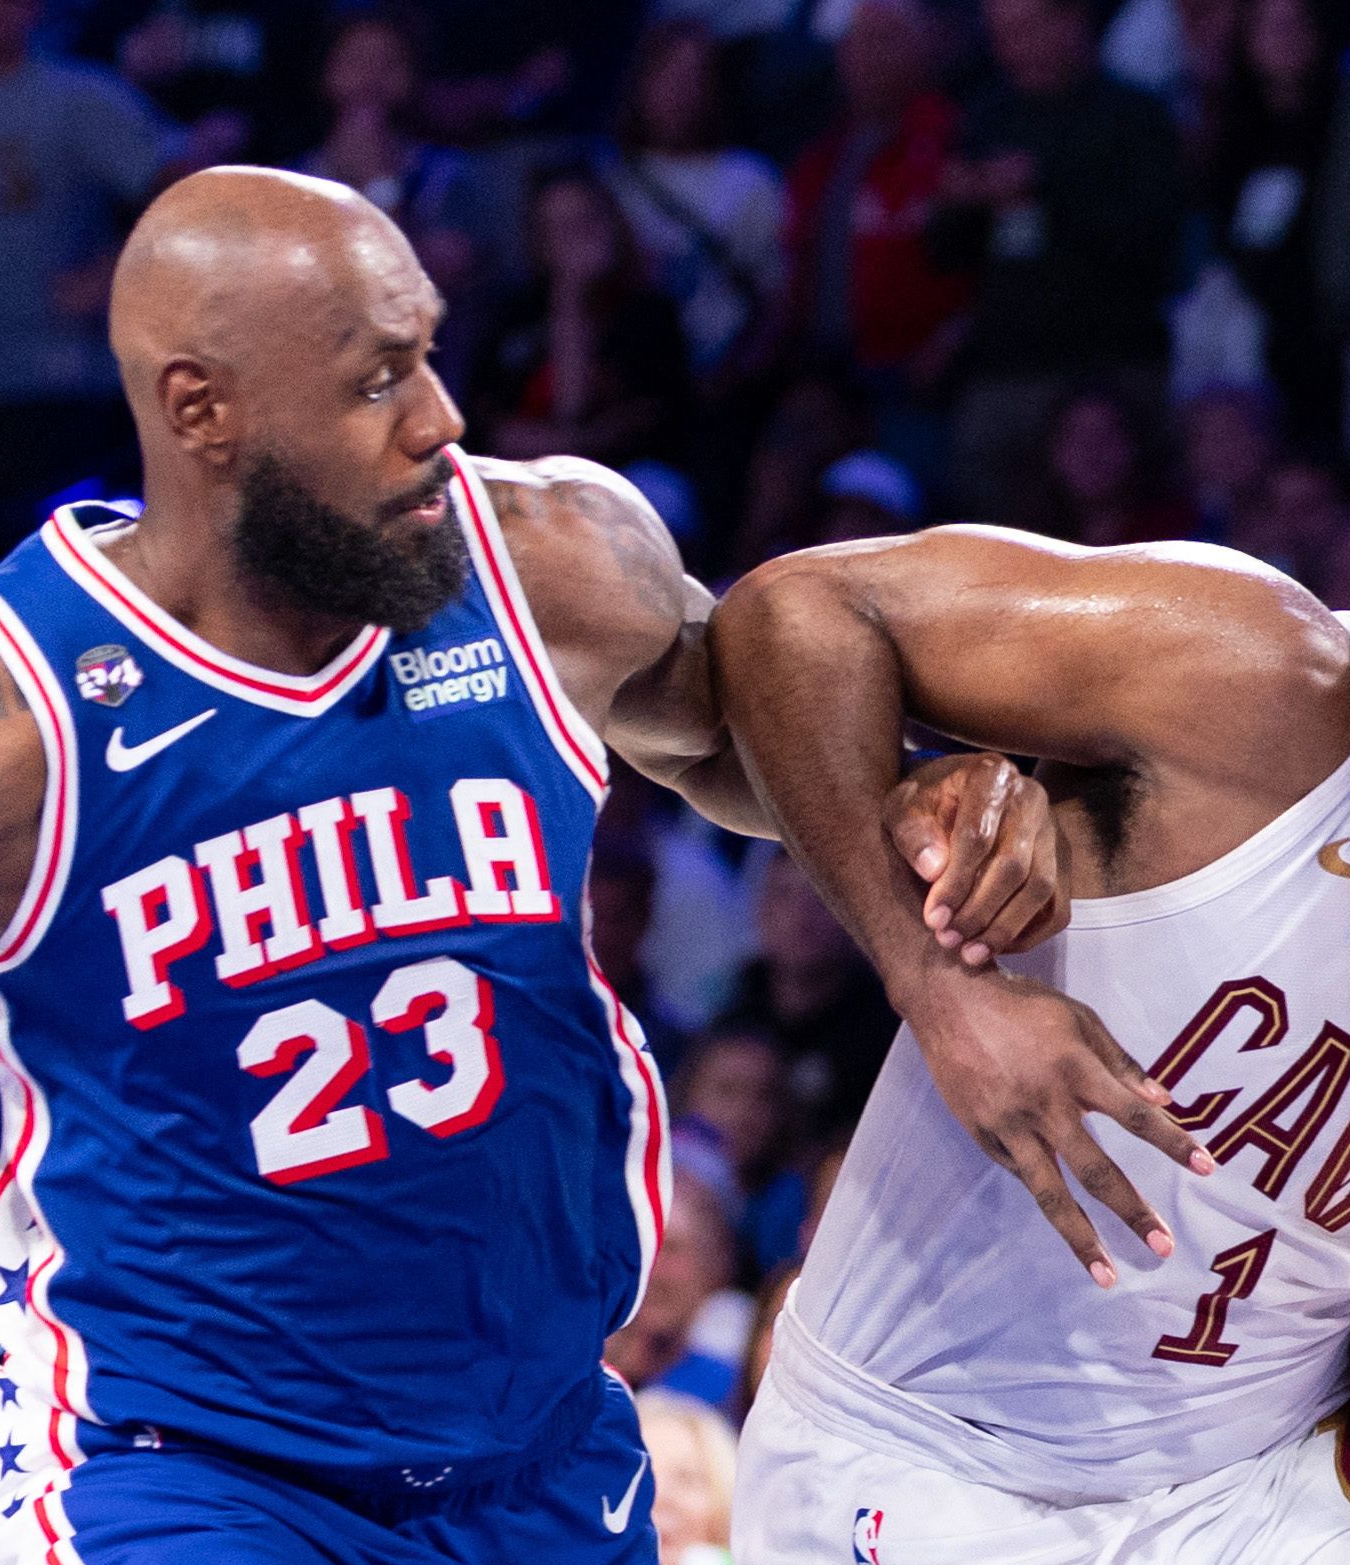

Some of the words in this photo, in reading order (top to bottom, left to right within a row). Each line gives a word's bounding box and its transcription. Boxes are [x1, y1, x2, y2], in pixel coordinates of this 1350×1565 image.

[390, 638, 504, 685] Bloom
[404, 666, 507, 711] energy
[101, 778, 561, 1031] PHILA
[236, 955, 506, 1185] 23
[1151, 1228, 1278, 1367] 1
